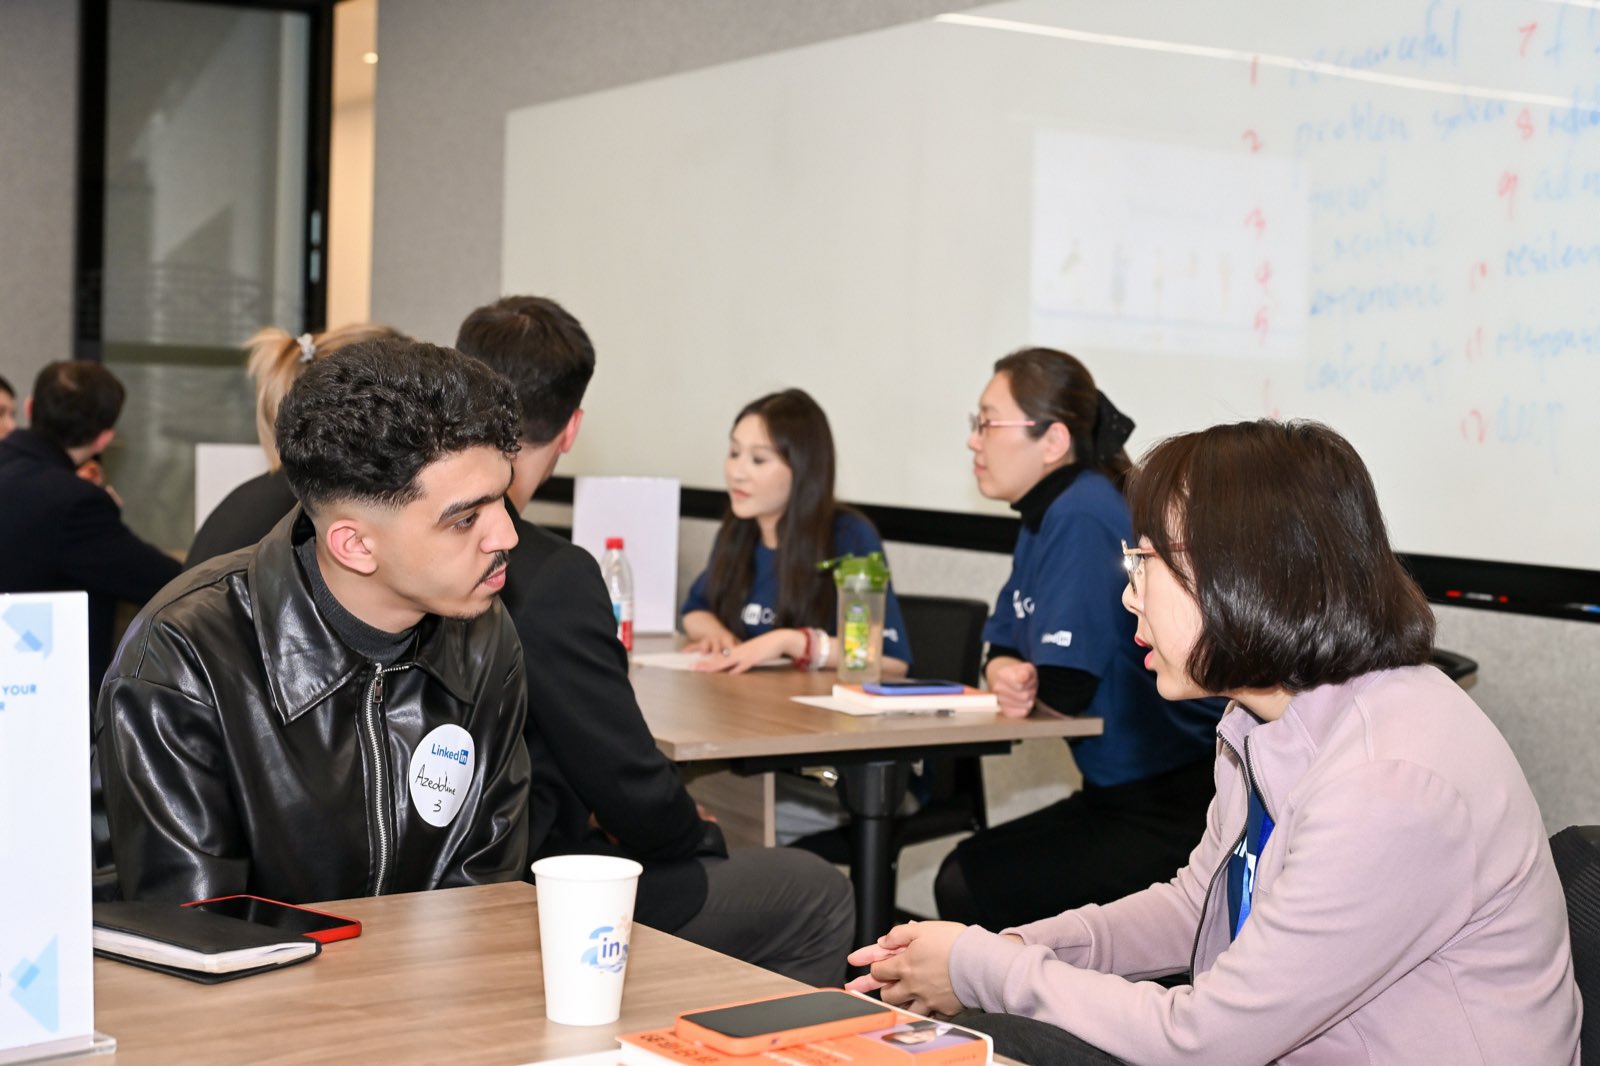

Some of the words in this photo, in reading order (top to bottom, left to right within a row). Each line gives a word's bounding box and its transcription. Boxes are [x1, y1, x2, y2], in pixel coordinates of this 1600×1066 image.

[1518, 23, 1538, 57] 7
[1241, 129, 1263, 153] 2
[432, 799, 443, 813] 3
